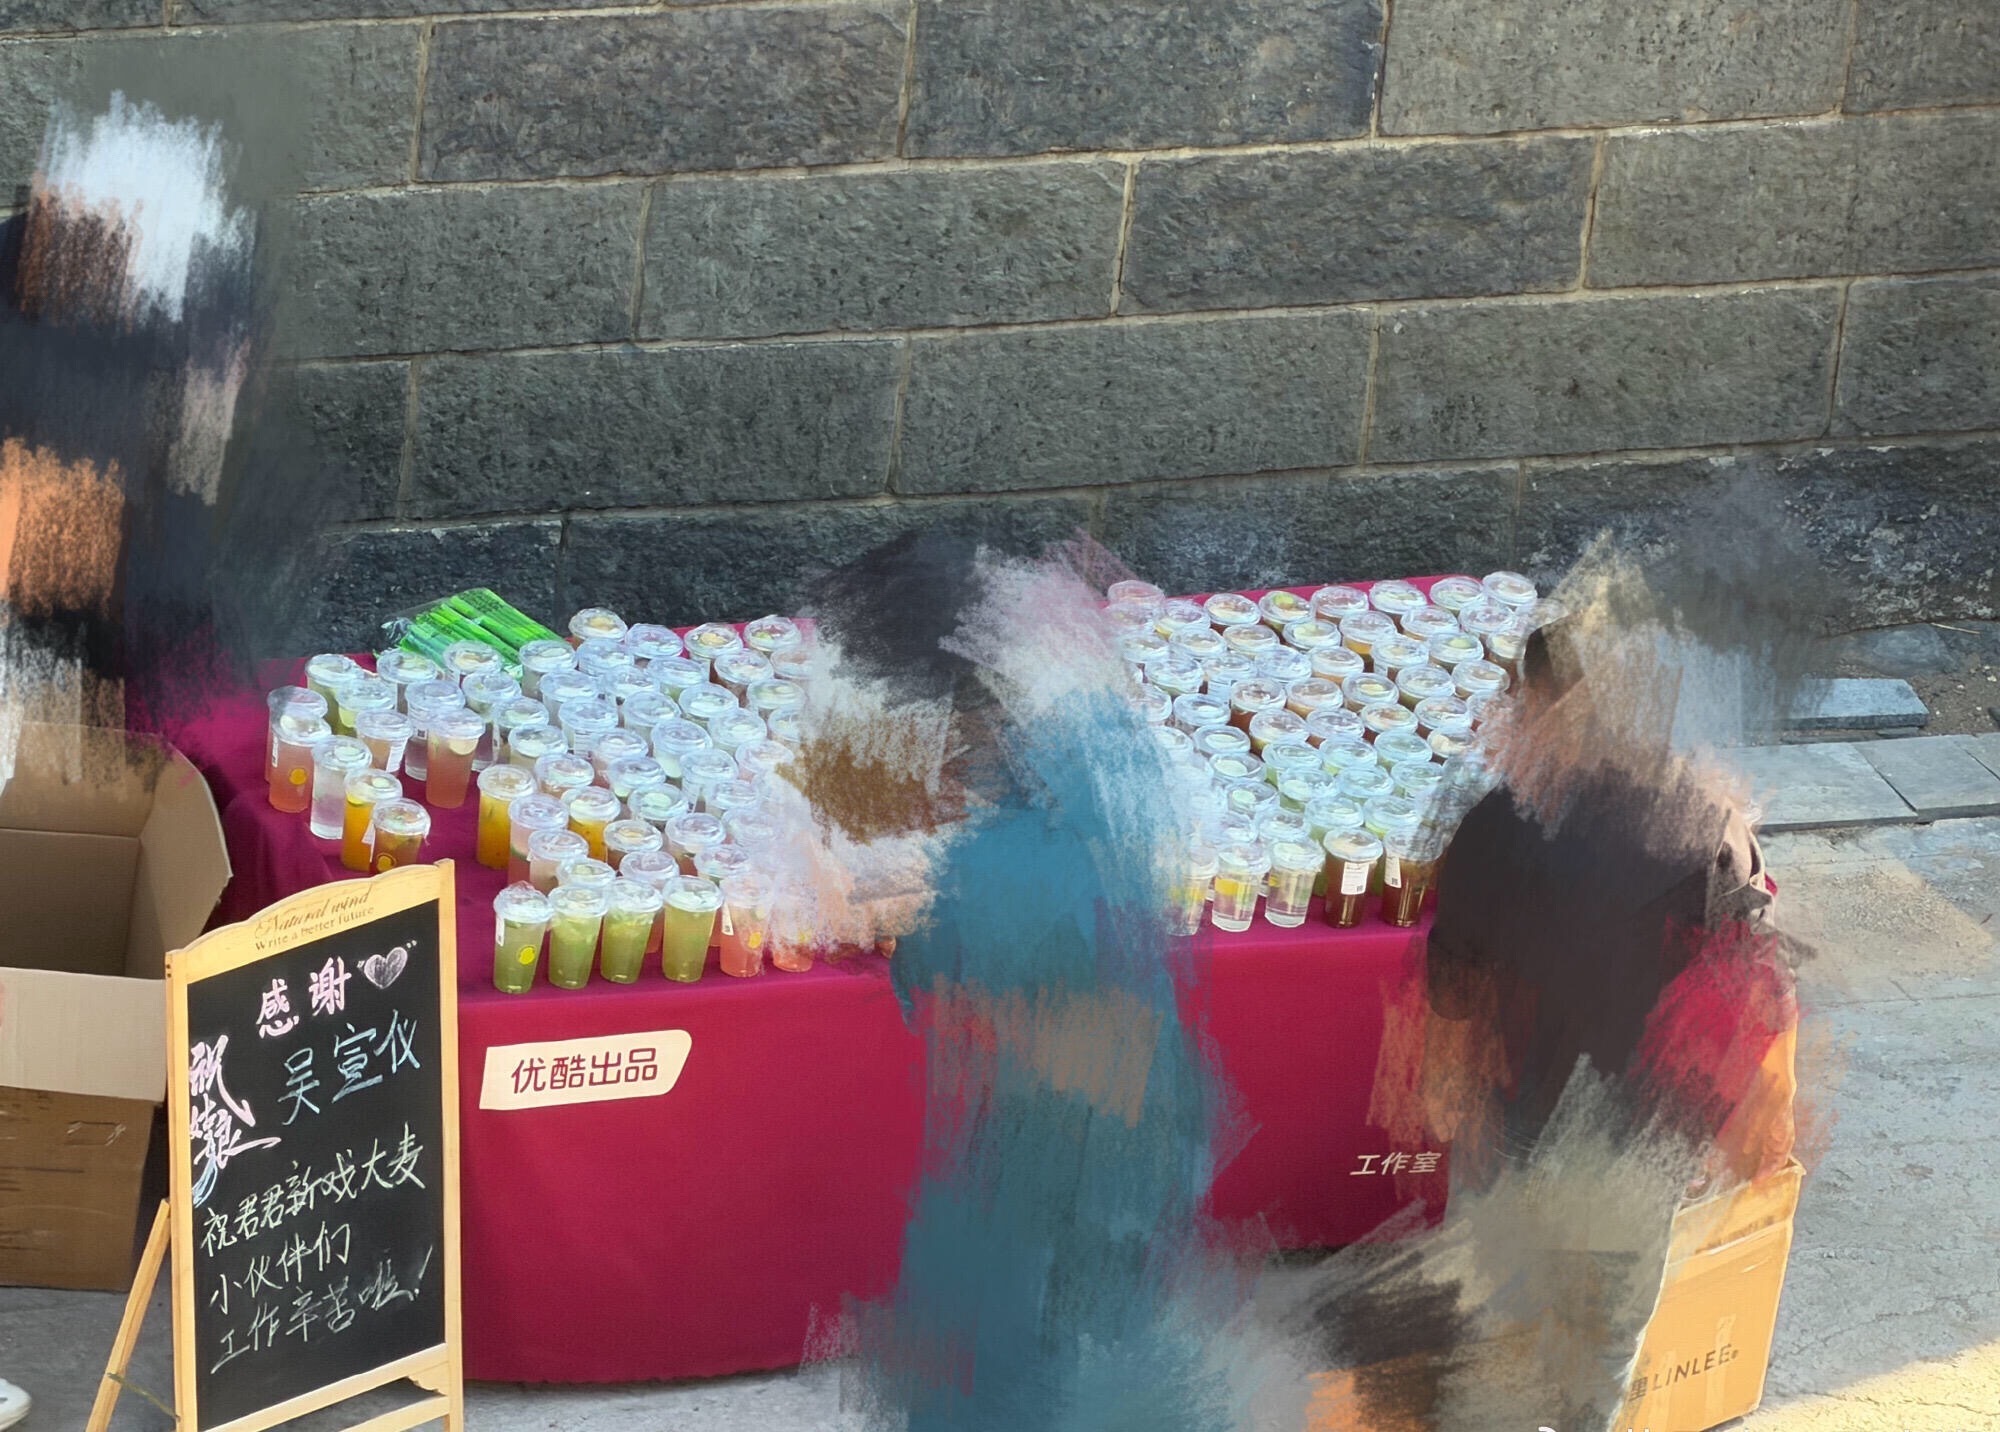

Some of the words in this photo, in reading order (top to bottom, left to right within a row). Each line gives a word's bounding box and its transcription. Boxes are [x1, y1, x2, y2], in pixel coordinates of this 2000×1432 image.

[255, 899, 330, 938] Natural
[331, 881, 374, 912] wind
[255, 934, 289, 950] Write
[301, 918, 334, 936] better
[338, 906, 375, 924] future
[256, 956, 352, 1039] 感谢
[278, 1009, 421, 1126] 吴宣仪
[510, 1047, 658, 1094] 优酷出品
[200, 1121, 426, 1258] 祝君君新戏大麦
[1350, 1151, 1442, 1176] 工作室
[209, 1220, 351, 1315] 小伙伴们
